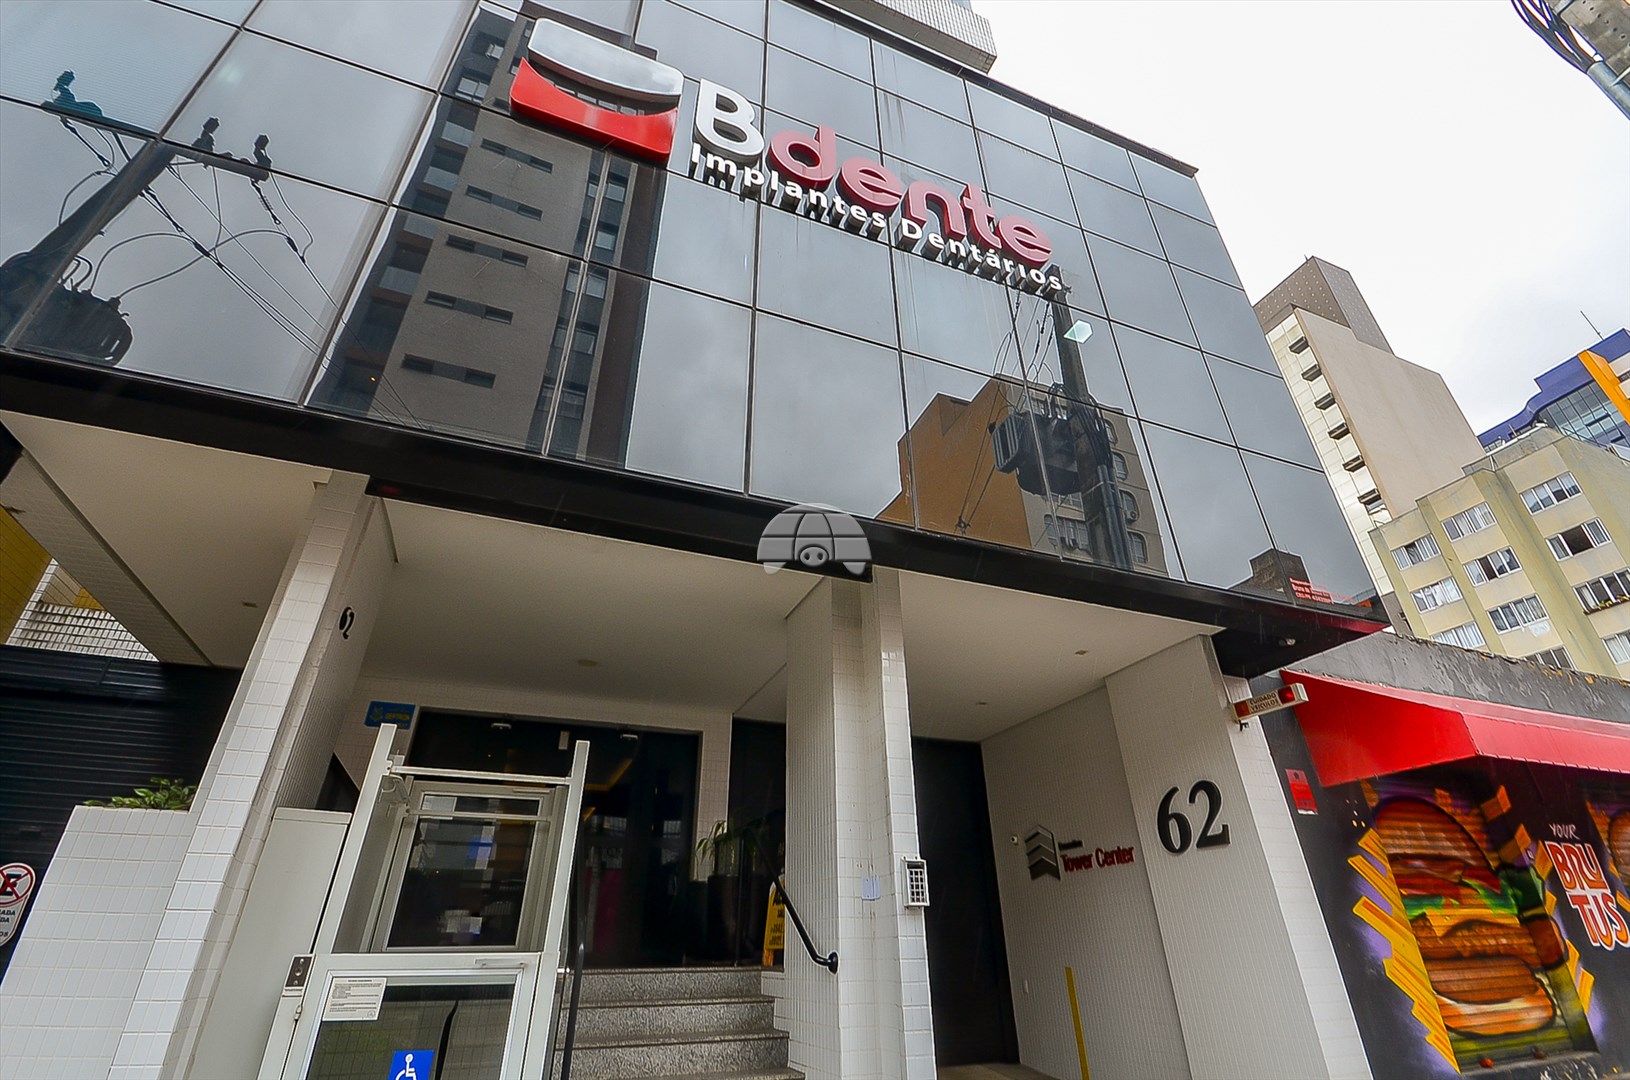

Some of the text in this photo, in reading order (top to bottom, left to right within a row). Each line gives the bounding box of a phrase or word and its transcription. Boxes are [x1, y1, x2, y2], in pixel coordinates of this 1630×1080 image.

[691, 143, 887, 229] Implantes
[695, 78, 1053, 268] Bdente
[1157, 779, 1231, 855] 62
[1548, 823, 1580, 840] YOUR
[1060, 853, 1093, 873] Tower
[1095, 845, 1135, 868] Center
[1566, 890, 1630, 951] TUS
